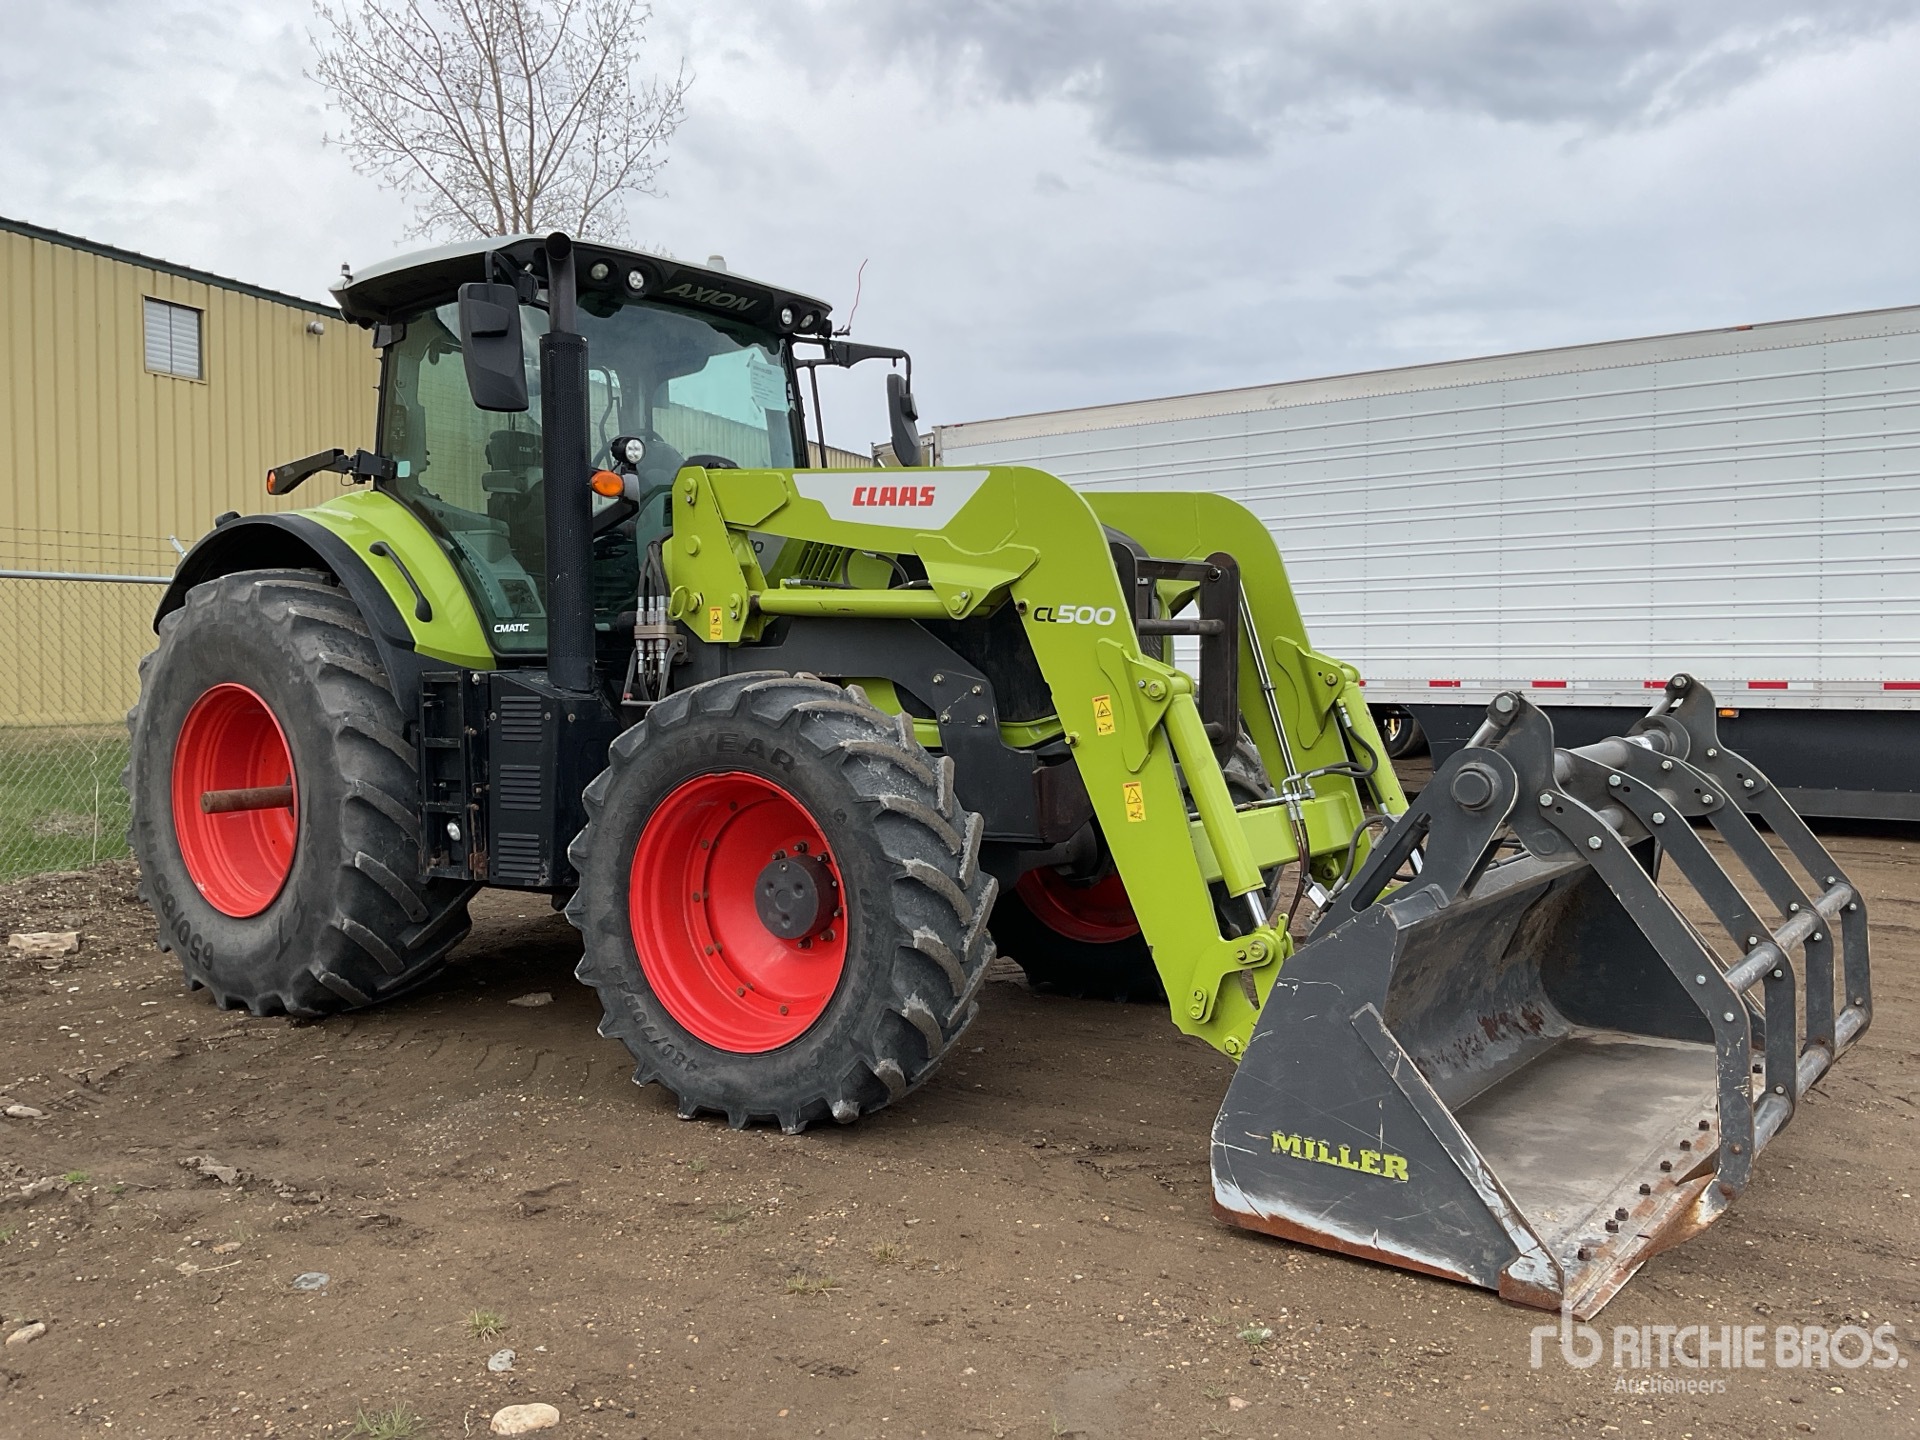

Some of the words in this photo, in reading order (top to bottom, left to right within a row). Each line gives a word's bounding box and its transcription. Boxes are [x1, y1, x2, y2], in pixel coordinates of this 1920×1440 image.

[664, 283, 758, 311] AXION
[852, 486, 936, 507] CLAAS
[1033, 605, 1116, 626] CL500
[493, 623, 530, 633] CMATIC
[1271, 1129, 1409, 1182] MILLER
